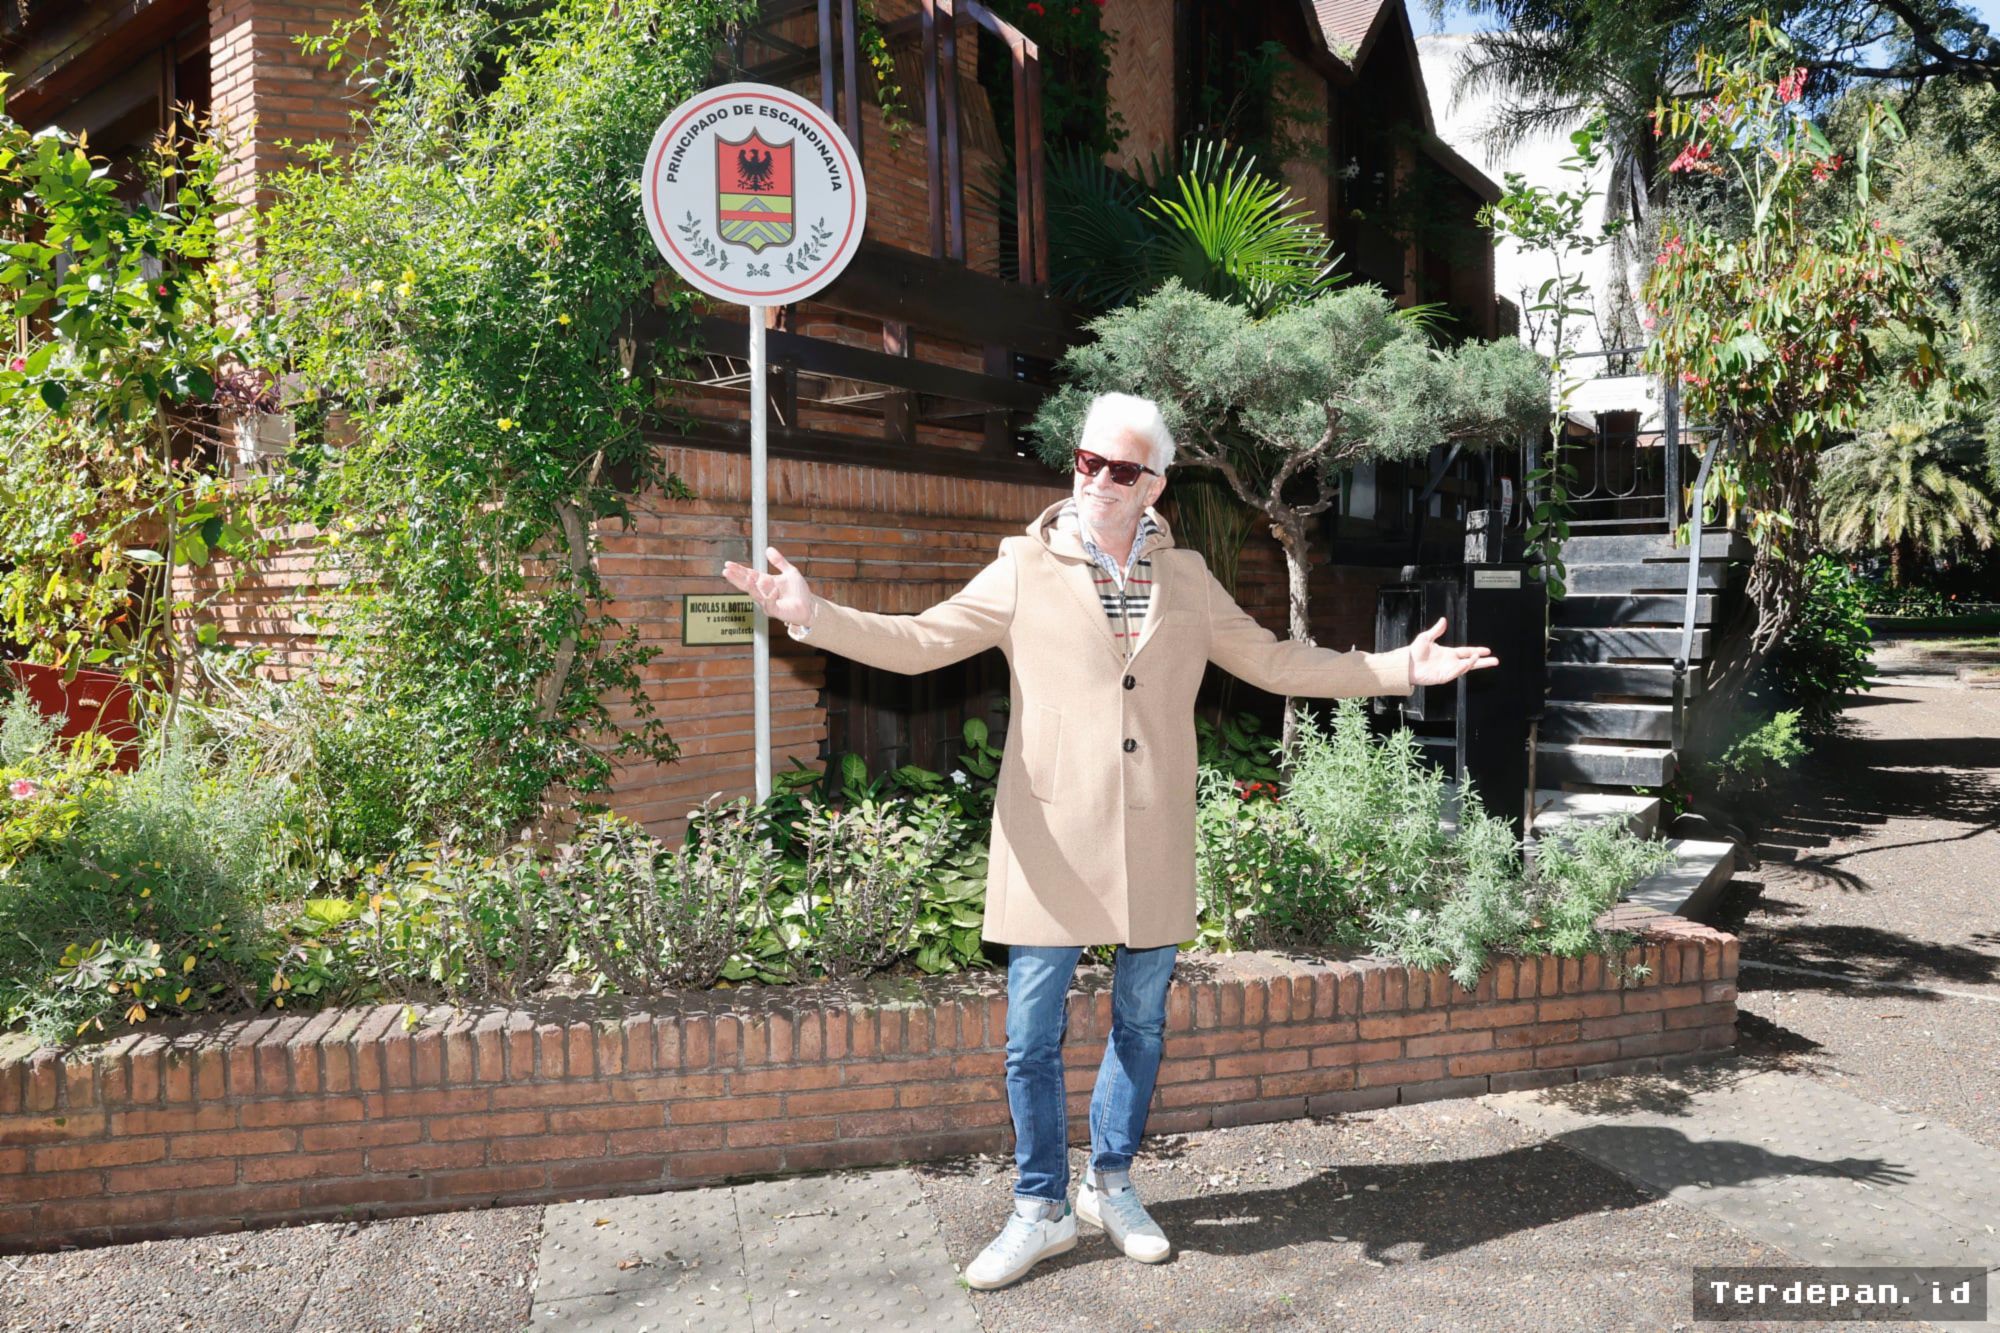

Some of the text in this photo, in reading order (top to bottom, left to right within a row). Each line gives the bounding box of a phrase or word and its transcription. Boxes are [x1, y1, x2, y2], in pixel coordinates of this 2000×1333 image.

[666, 104, 843, 192] PRINCIPADO DE ESCANDINAVIA
[690, 602, 720, 613] NICOLAS
[728, 602, 754, 613] BOTTAZZ
